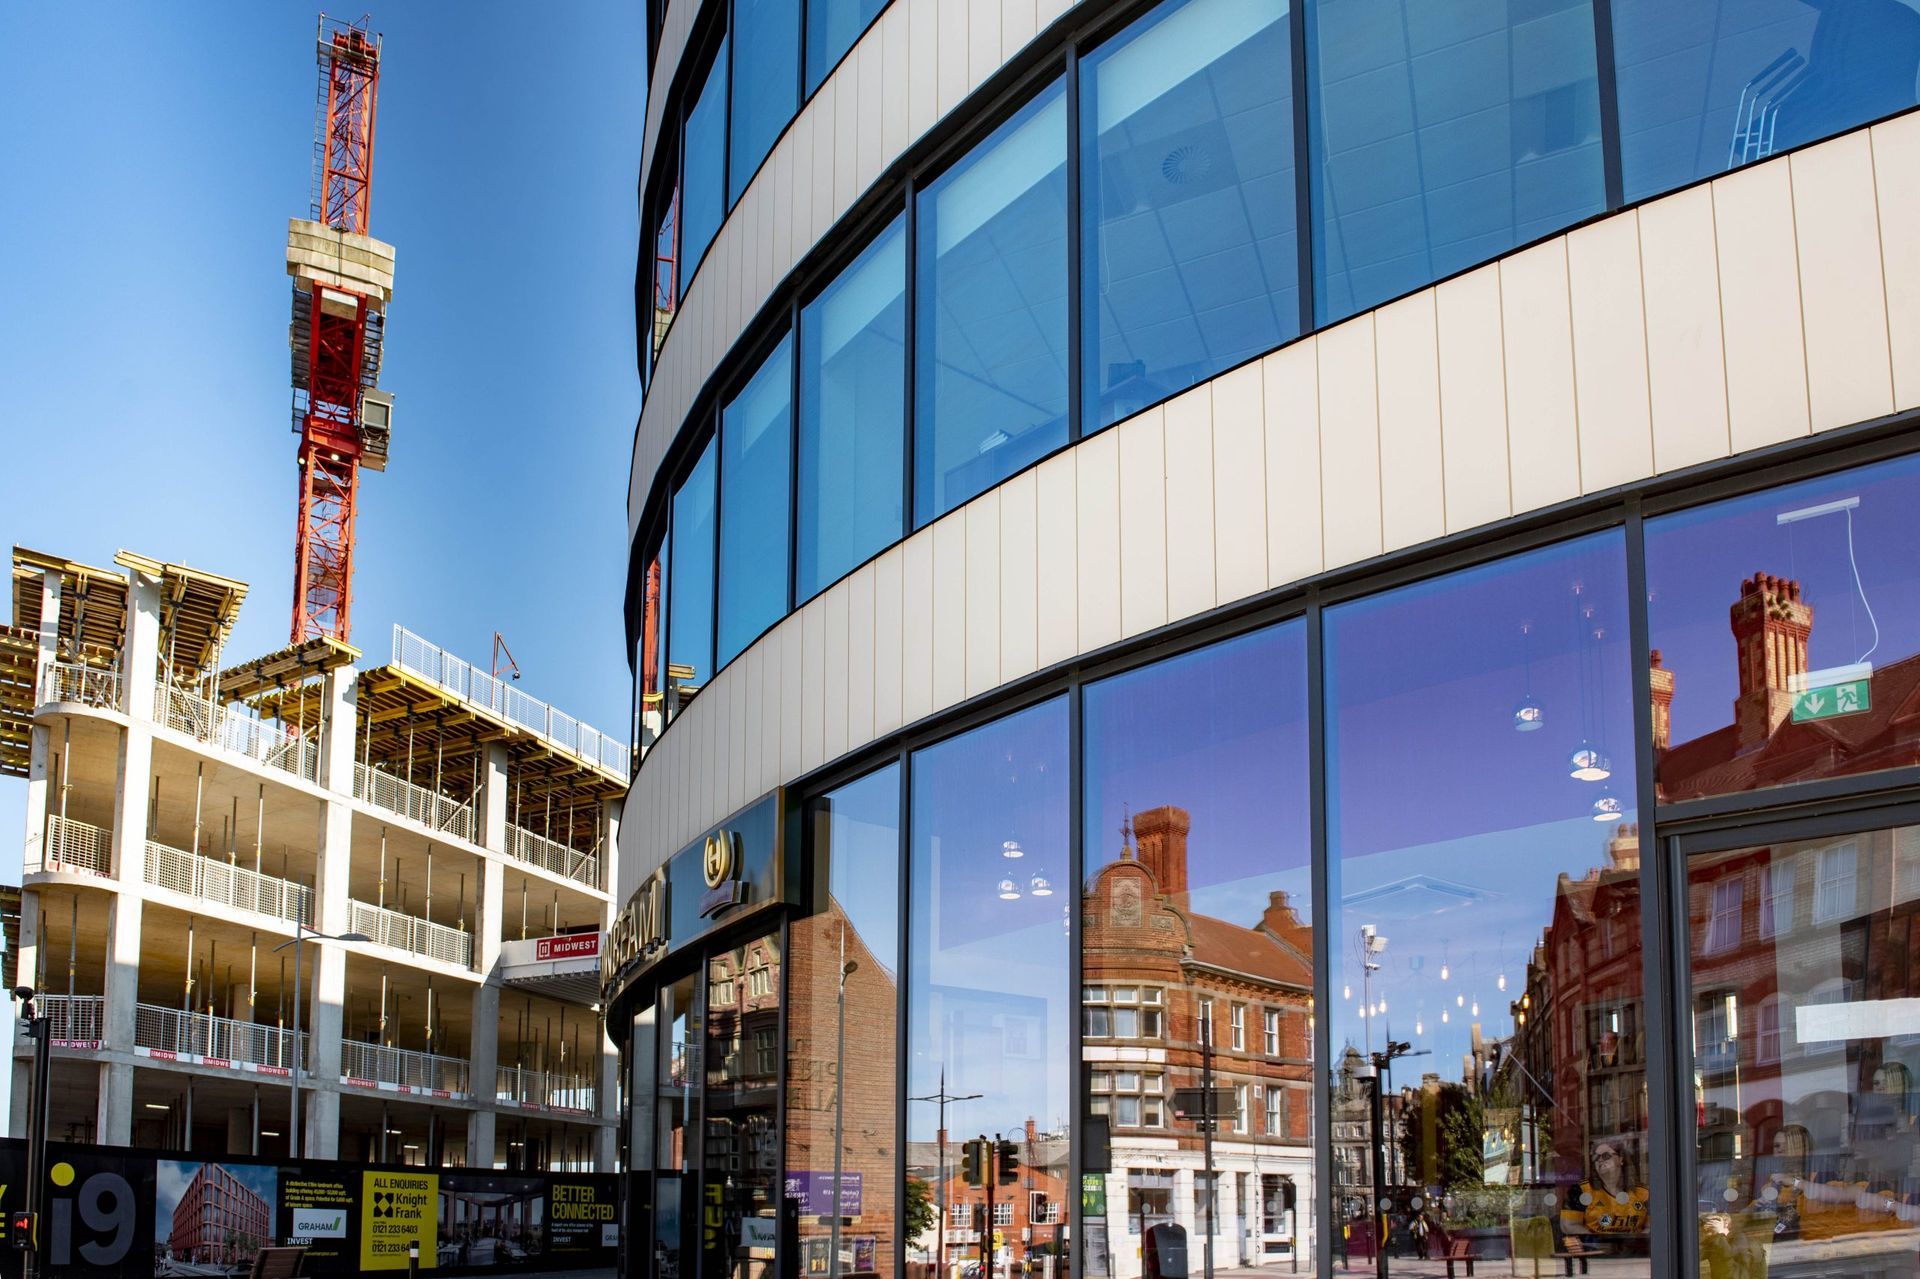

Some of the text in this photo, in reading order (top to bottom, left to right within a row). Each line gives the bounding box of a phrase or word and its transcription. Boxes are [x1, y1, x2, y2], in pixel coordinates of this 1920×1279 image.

[553, 940, 597, 953] MIDWEST
[374, 1178, 428, 1190] ALL ENQUIRIES
[552, 1184, 595, 1203] BETTER
[396, 1193, 427, 1208] Knight
[50, 1162, 136, 1266] i9
[395, 1207, 422, 1219] Frank
[551, 1202, 614, 1220] CONNECTED
[298, 1222, 333, 1231] GRAHAM
[373, 1225, 387, 1233] 0121
[388, 1225, 400, 1234] 233
[287, 1237, 313, 1245] INVEST
[372, 1244, 386, 1252] 0121
